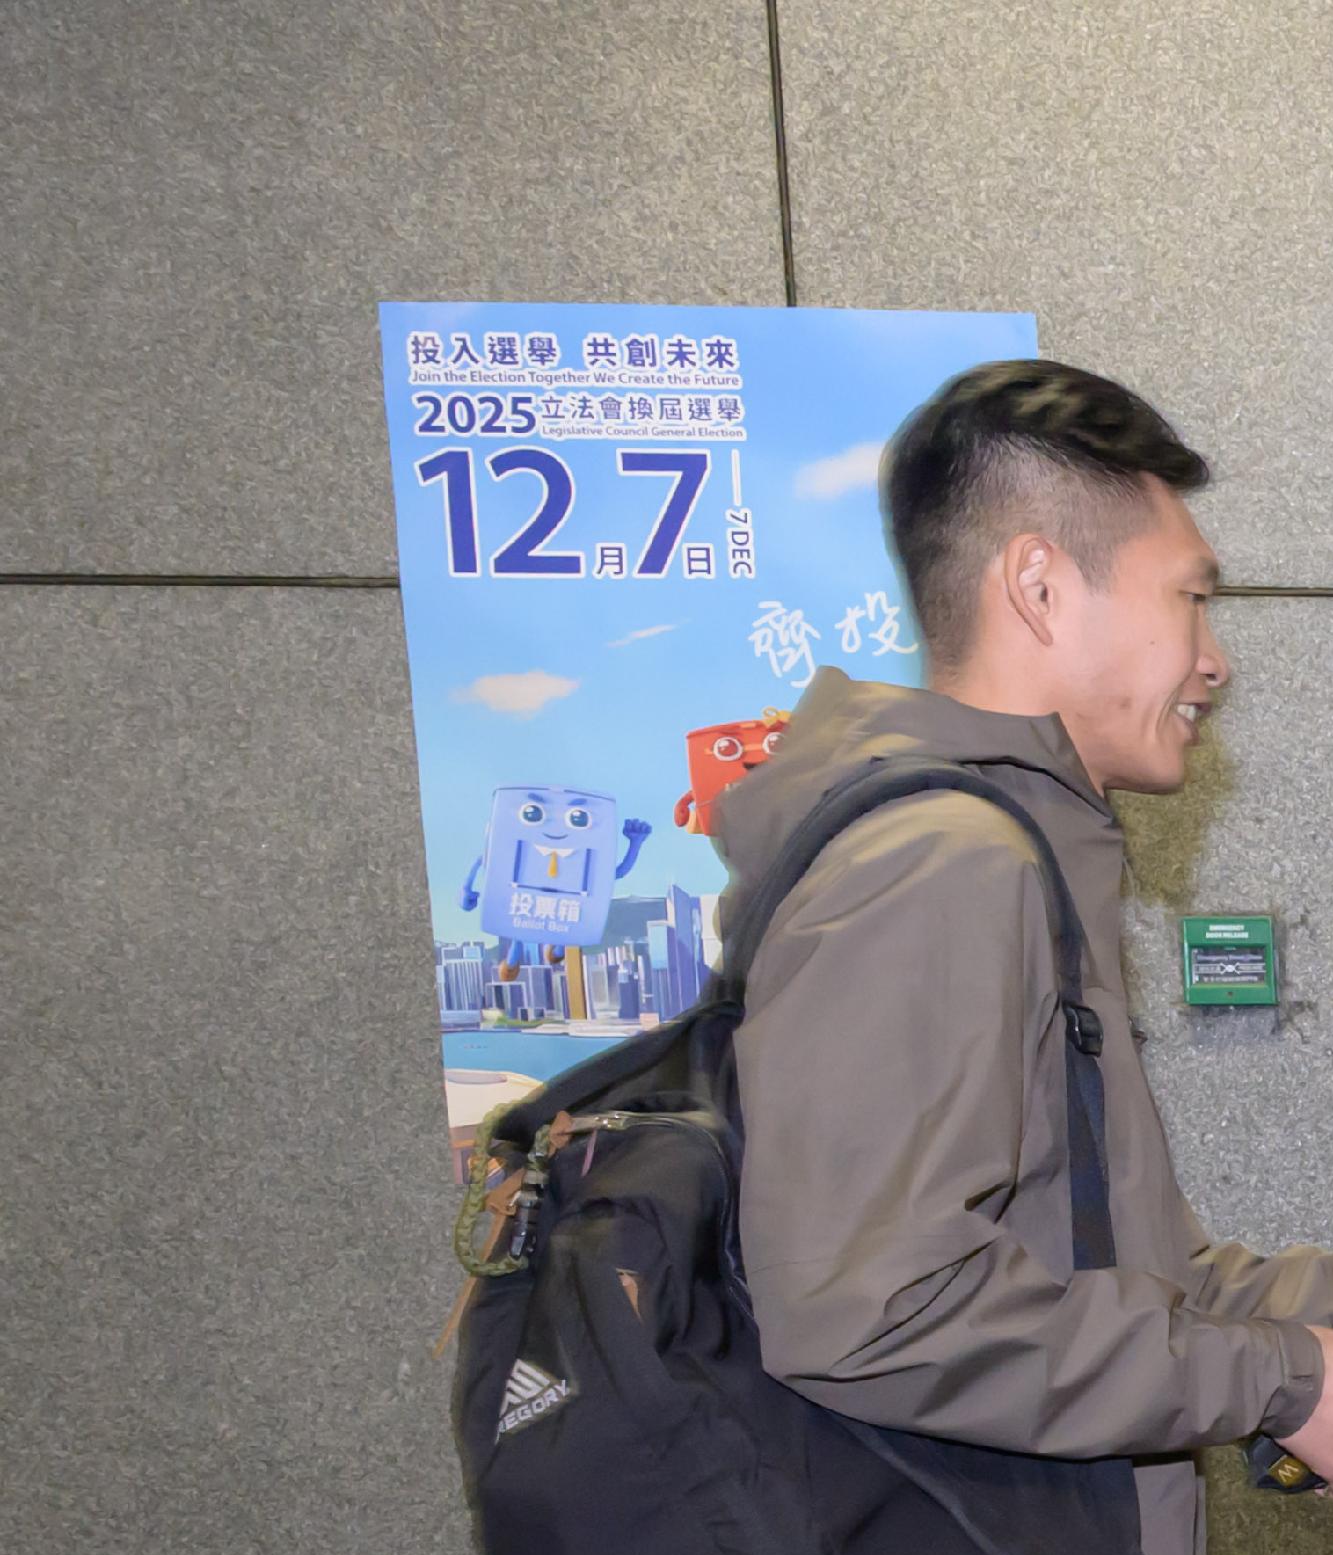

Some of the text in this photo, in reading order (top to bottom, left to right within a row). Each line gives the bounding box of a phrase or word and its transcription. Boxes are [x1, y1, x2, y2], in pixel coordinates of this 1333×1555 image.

[410, 335, 737, 369] 投入選舉 共創未來
[412, 370, 739, 386] Join the Election Together We Create the Future
[416, 395, 742, 434] 2025 立法會換屆選舉
[542, 425, 743, 438] Legislative Council General Election
[418, 449, 712, 576] 12月7日
[730, 531, 753, 576] DEC
[747, 591, 919, 687] 齊投
[509, 892, 581, 923] 投票箱
